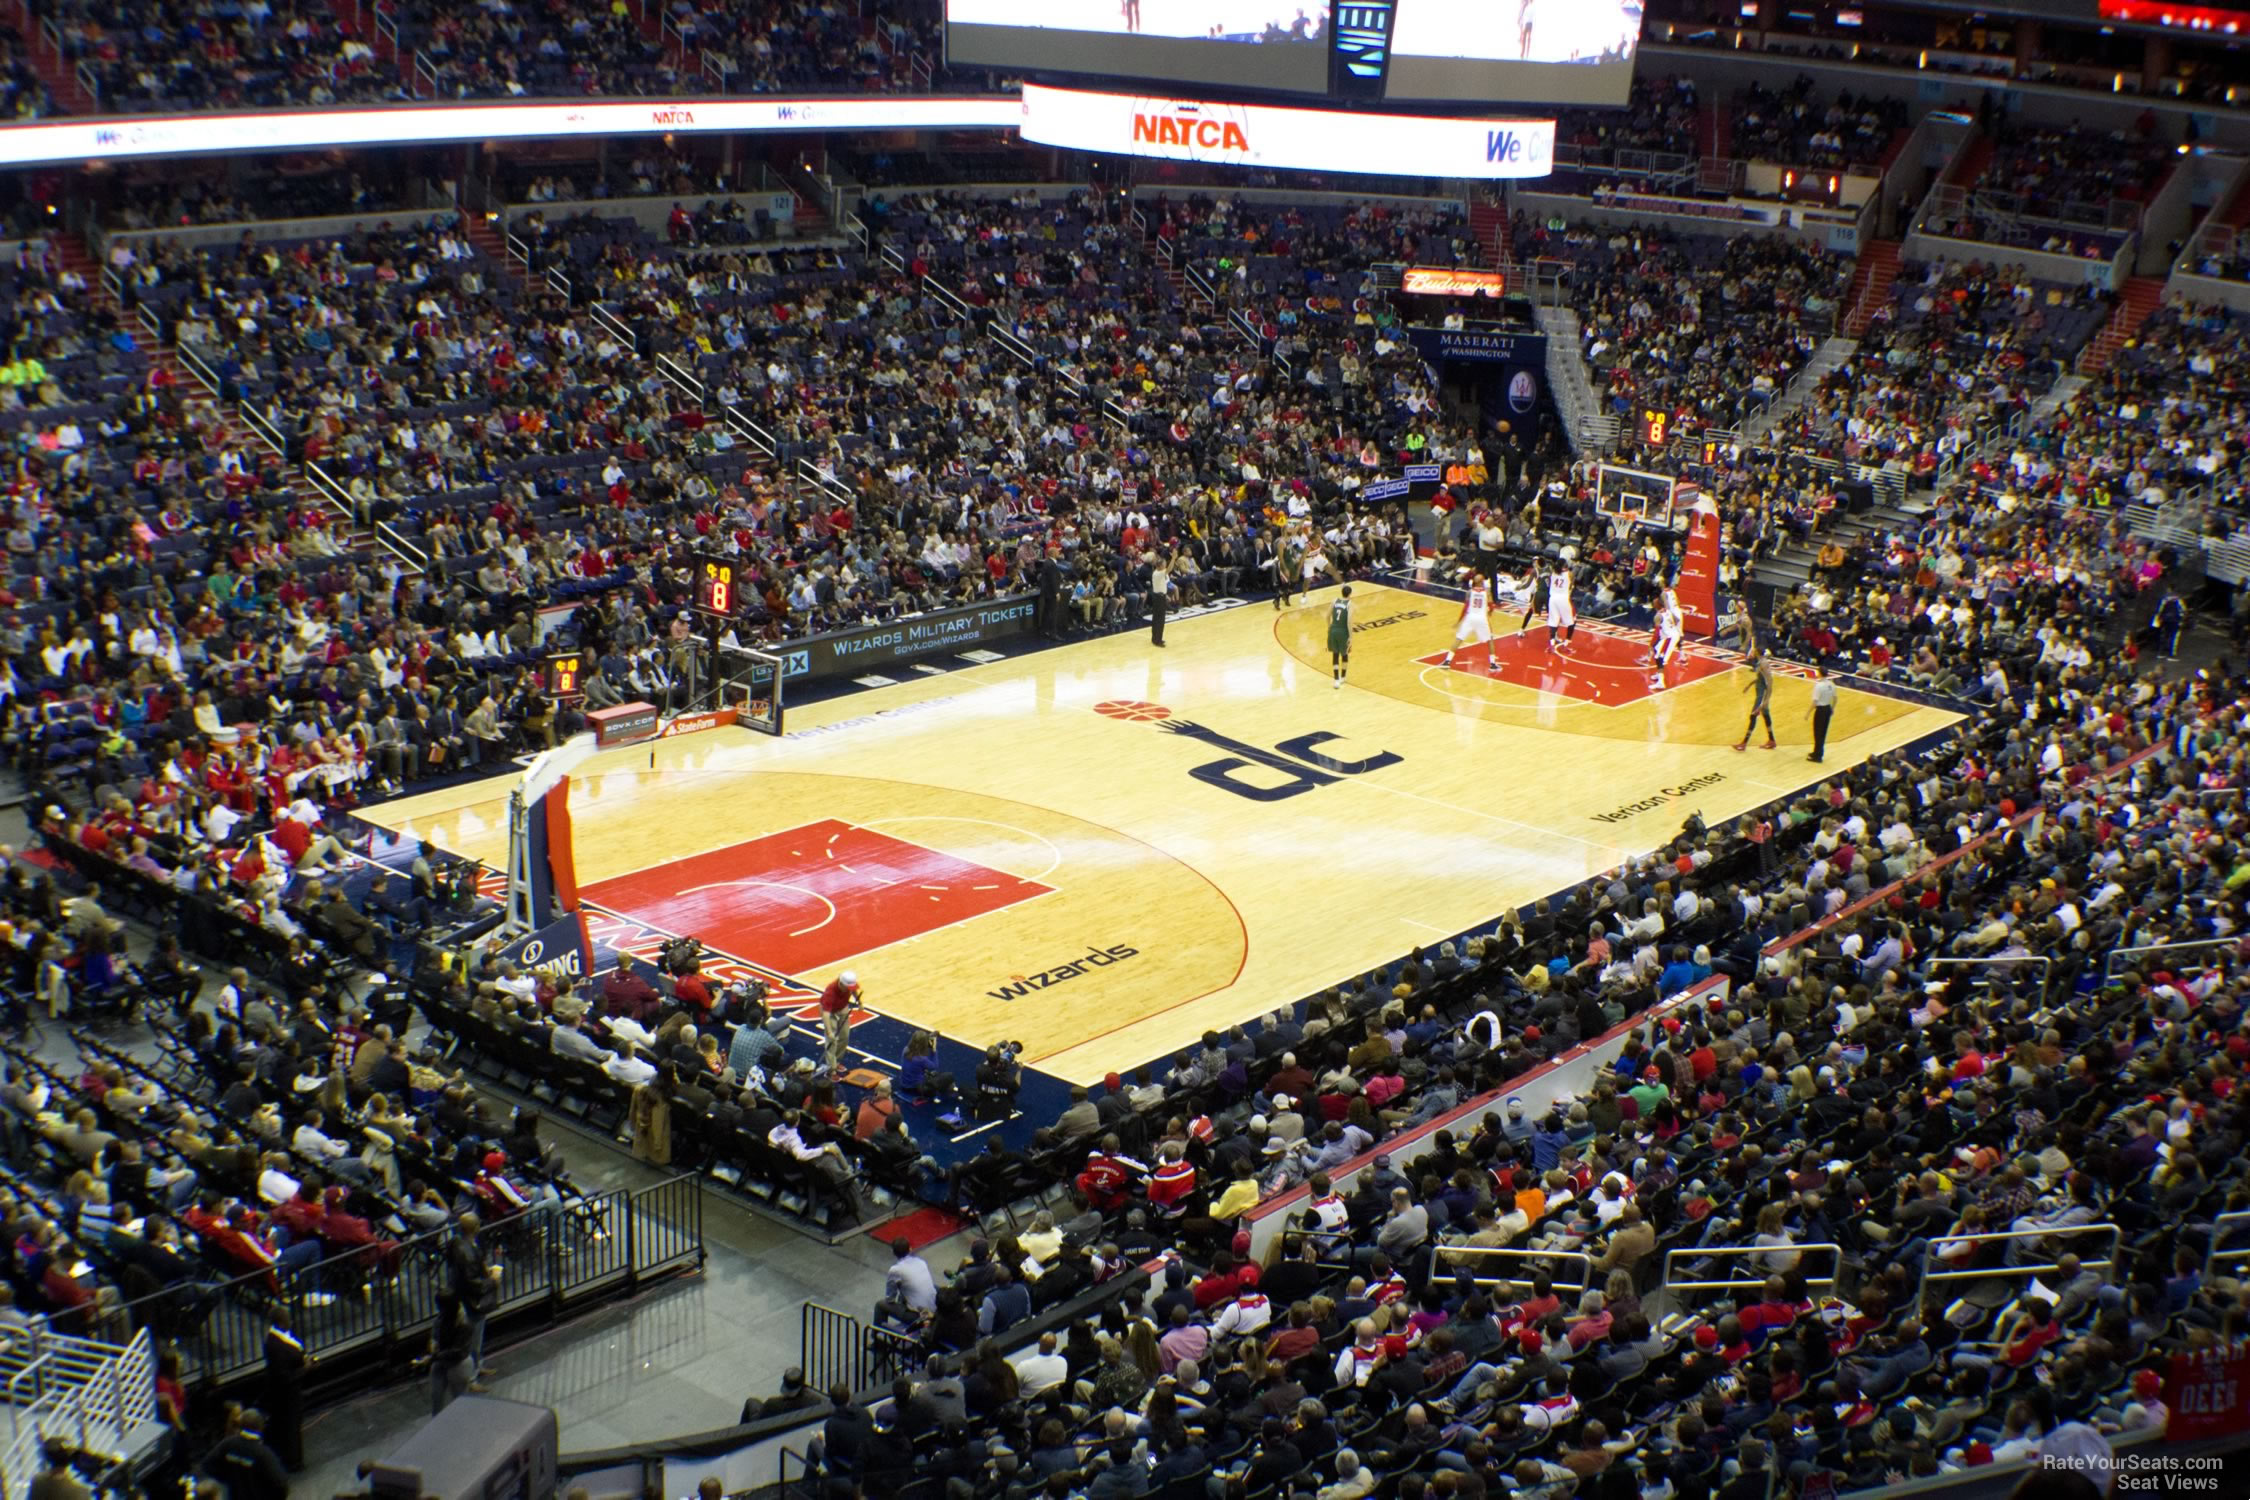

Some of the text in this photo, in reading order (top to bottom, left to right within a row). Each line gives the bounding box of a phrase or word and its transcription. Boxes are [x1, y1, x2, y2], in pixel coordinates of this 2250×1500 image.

[652, 110, 694, 124] NATCA
[1133, 113, 1249, 151] NATCA
[1486, 130, 1521, 163] We
[1439, 335, 1515, 349] MASERATI
[1441, 347, 1511, 359] of WASHINGTON
[1651, 423, 1662, 443] 8
[1407, 468, 1439, 477] GEICO
[706, 563, 731, 584] 9:10
[713, 582, 727, 611] 8
[832, 604, 1034, 657] WIZARDS MILITARY TICKETS
[561, 673, 571, 690] 8
[1589, 772, 1728, 823] Verizon Center
[985, 943, 1140, 1001] wizards
